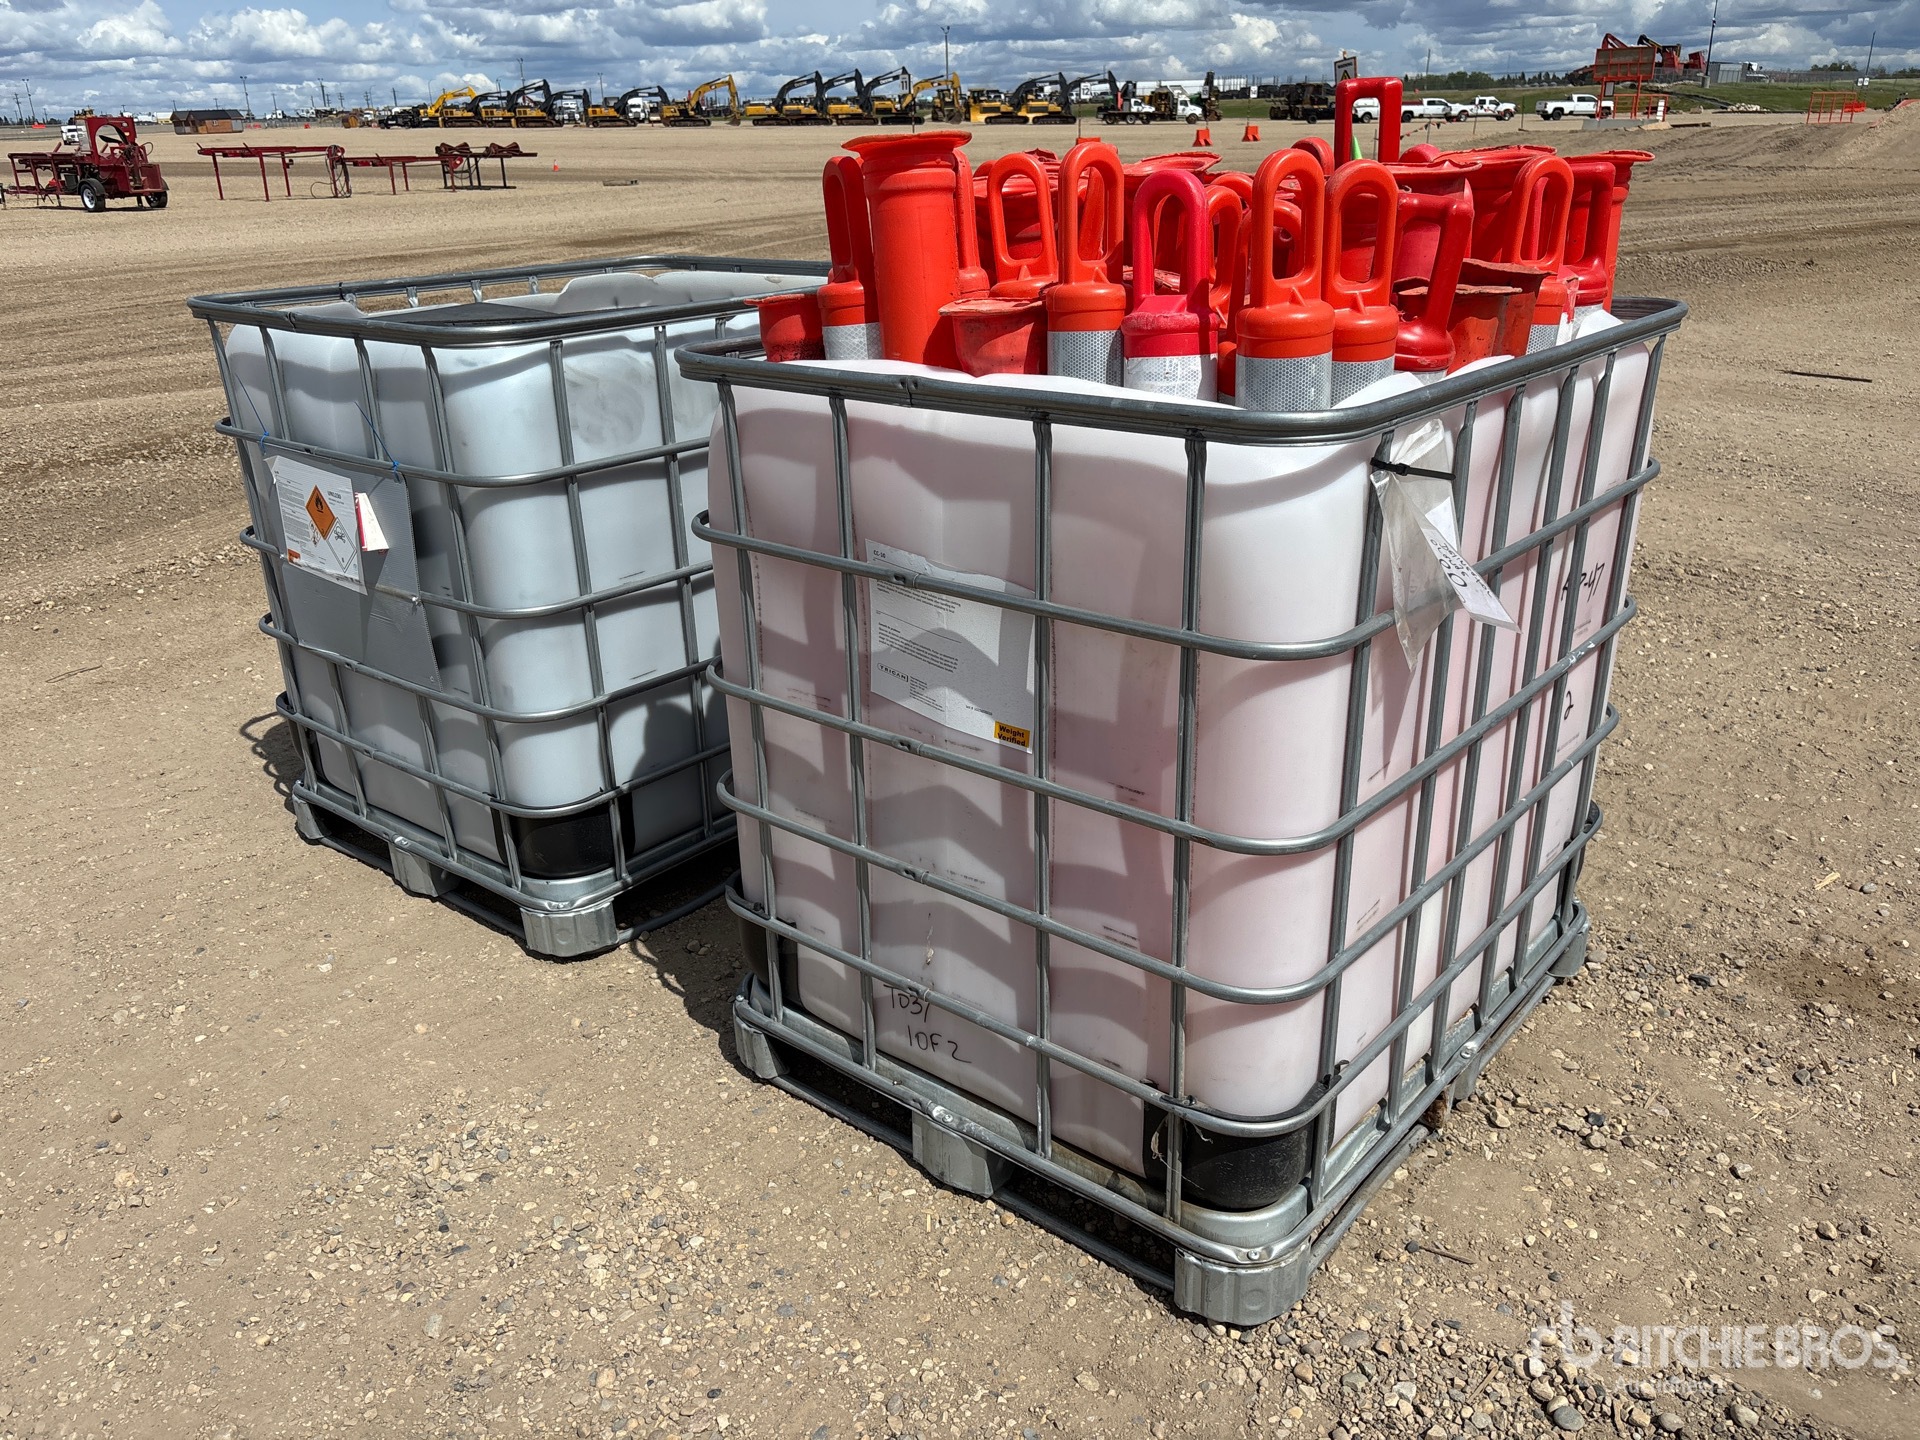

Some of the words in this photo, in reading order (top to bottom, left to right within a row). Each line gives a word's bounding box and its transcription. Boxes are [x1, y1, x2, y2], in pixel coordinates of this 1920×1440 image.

[1081, 87, 1090, 96] 12
[879, 664, 906, 680] TRICAN
[998, 724, 1025, 739] Weight
[997, 732, 1026, 747] Verified
